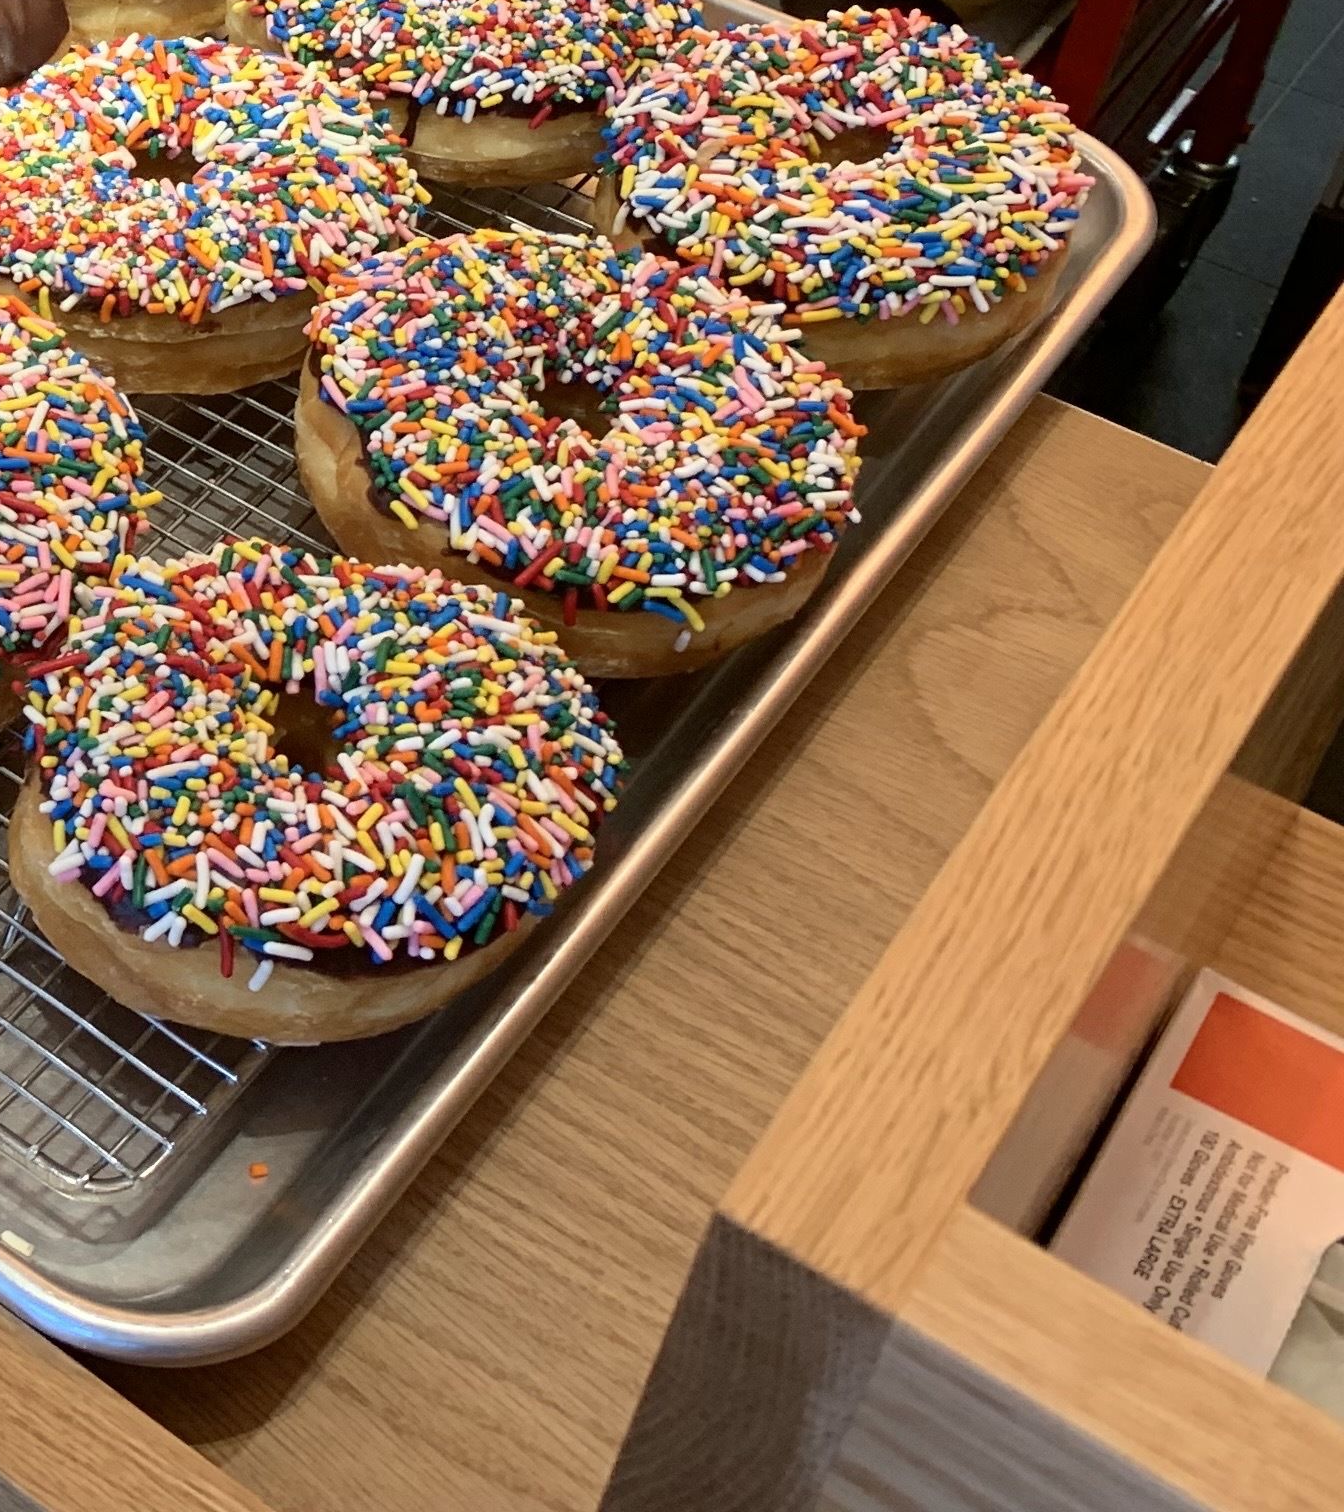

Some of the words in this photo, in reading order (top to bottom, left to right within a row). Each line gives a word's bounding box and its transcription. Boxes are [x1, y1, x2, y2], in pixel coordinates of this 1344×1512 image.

[1199, 1128, 1219, 1150] 100
[1179, 1148, 1209, 1188] Gloves
[1155, 1195, 1186, 1236] EXTRA
[1215, 1189, 1247, 1235] Medical
[1133, 1236, 1165, 1280] LARGE
[1170, 1221, 1201, 1260] Single
[1202, 1233, 1225, 1258] Use
[1228, 1230, 1255, 1260] Vinyl
[1160, 1260, 1182, 1285] Use
[1179, 1266, 1209, 1307] Rolled
[1210, 1259, 1241, 1301] Gloves
[1142, 1283, 1170, 1315] Only
